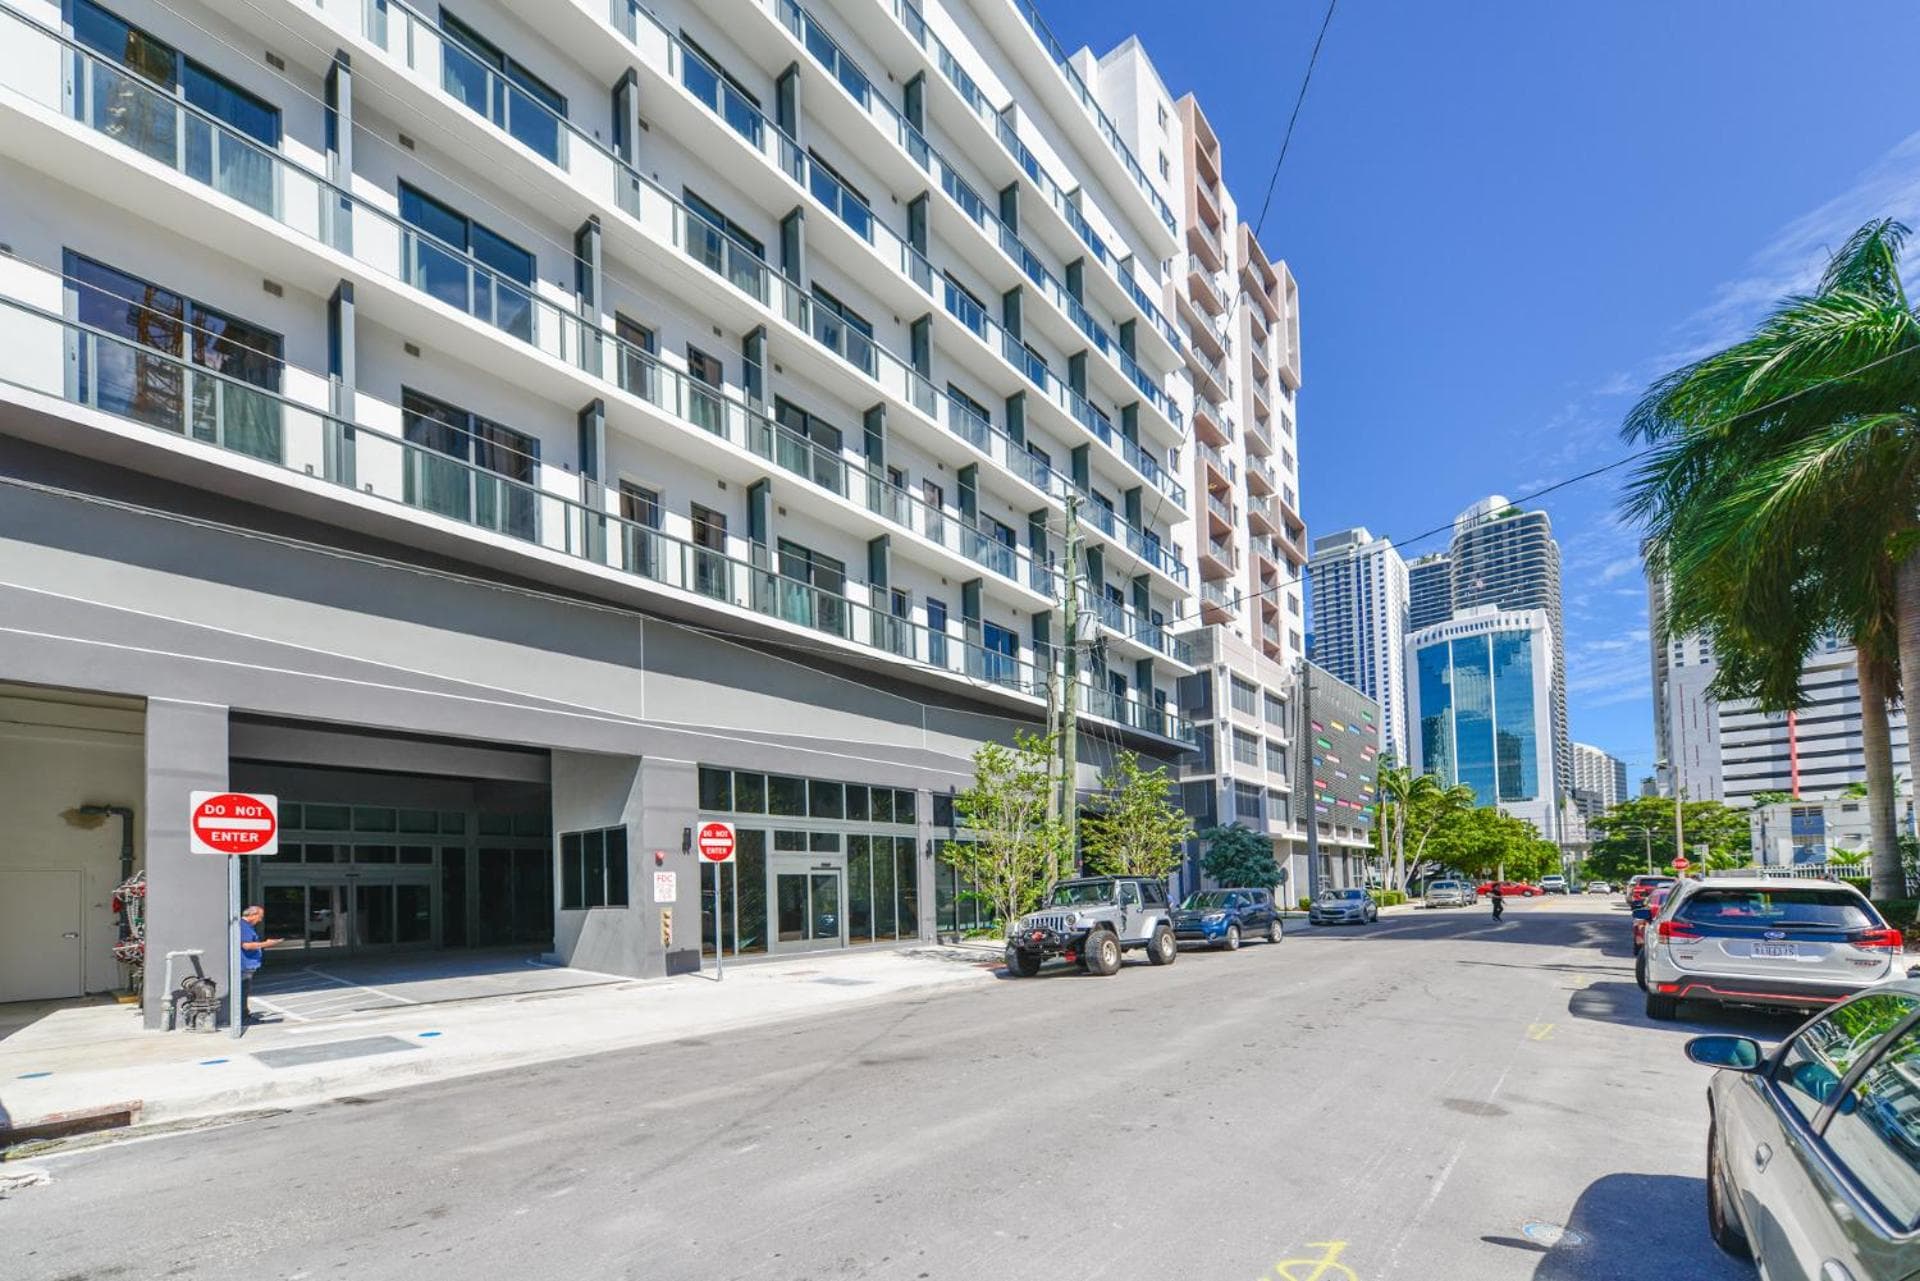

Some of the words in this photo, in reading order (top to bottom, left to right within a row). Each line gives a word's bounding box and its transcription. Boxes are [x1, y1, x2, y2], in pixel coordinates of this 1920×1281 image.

[204, 804, 226, 815] DO
[235, 806, 264, 816] NOT
[211, 831, 259, 842] ENTER
[715, 830, 728, 838] NOT
[706, 846, 727, 855] ENTER
[656, 874, 673, 883] FDC
